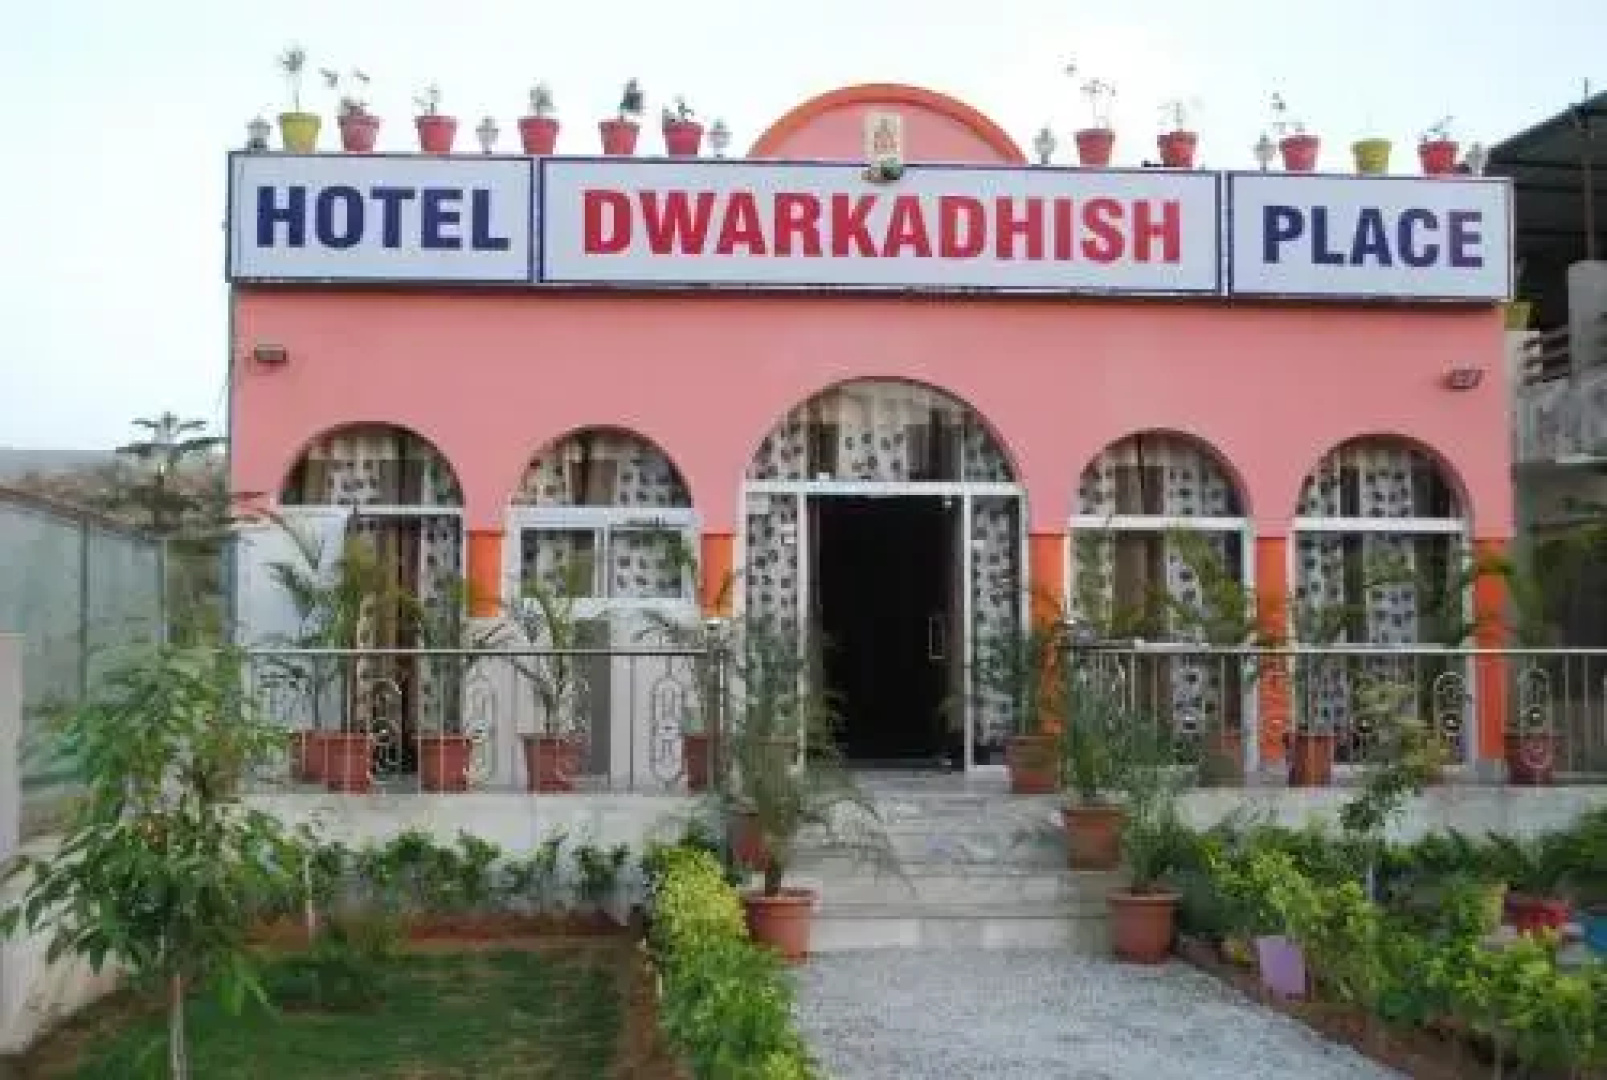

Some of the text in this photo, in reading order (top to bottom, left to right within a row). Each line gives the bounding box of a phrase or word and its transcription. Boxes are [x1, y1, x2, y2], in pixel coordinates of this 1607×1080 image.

[256, 185, 1484, 268] HOTEL DWARKADHISH PLACE
